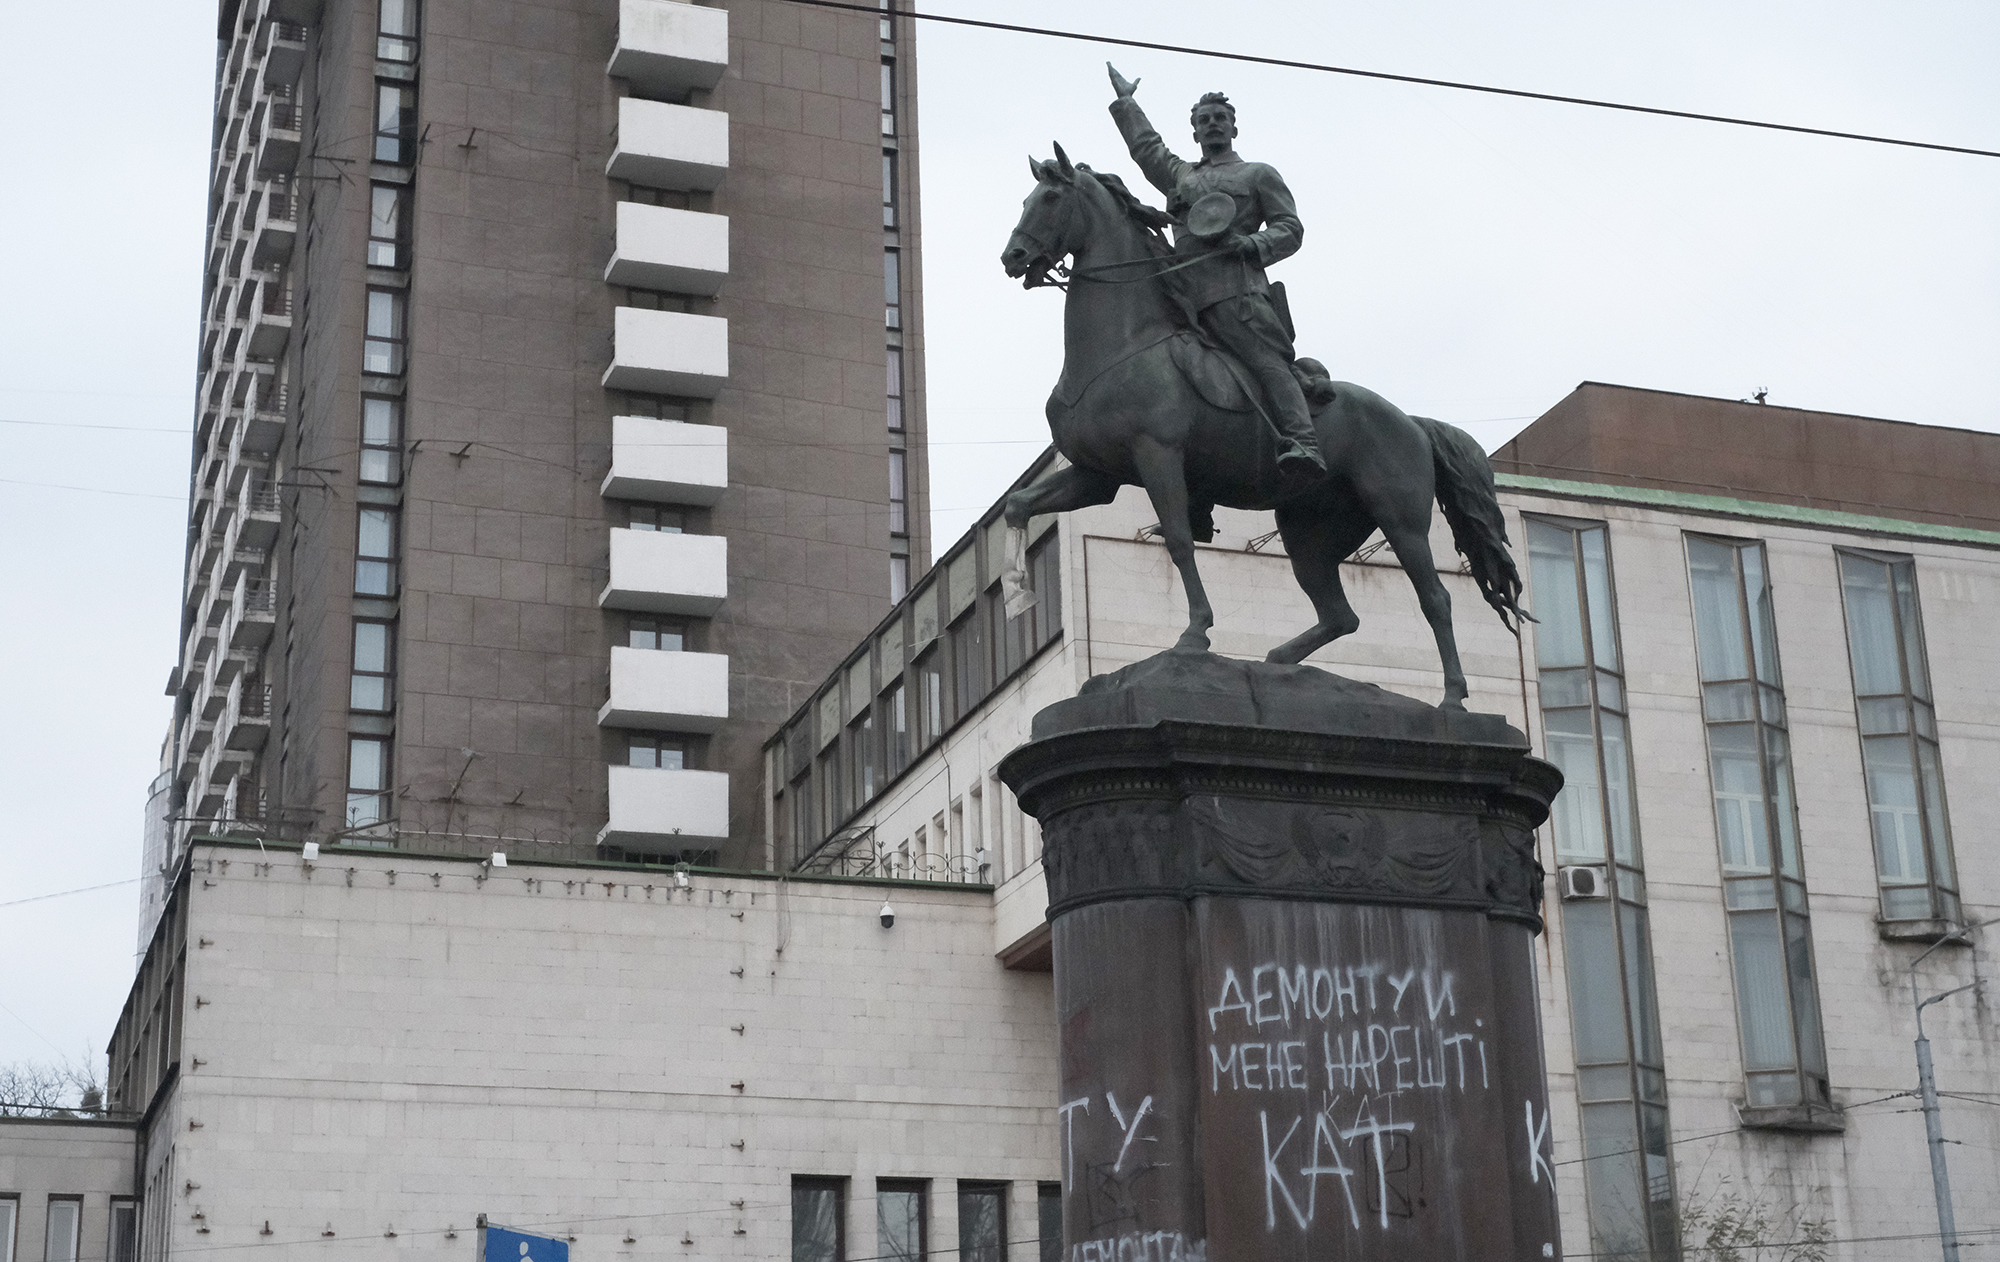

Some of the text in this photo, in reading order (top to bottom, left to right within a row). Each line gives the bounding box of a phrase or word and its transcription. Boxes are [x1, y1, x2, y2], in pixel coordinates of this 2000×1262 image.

[1210, 1018, 1489, 1095] МЕНЕ НАРЕШТІ
[1260, 1111, 1415, 1231] КАТ
